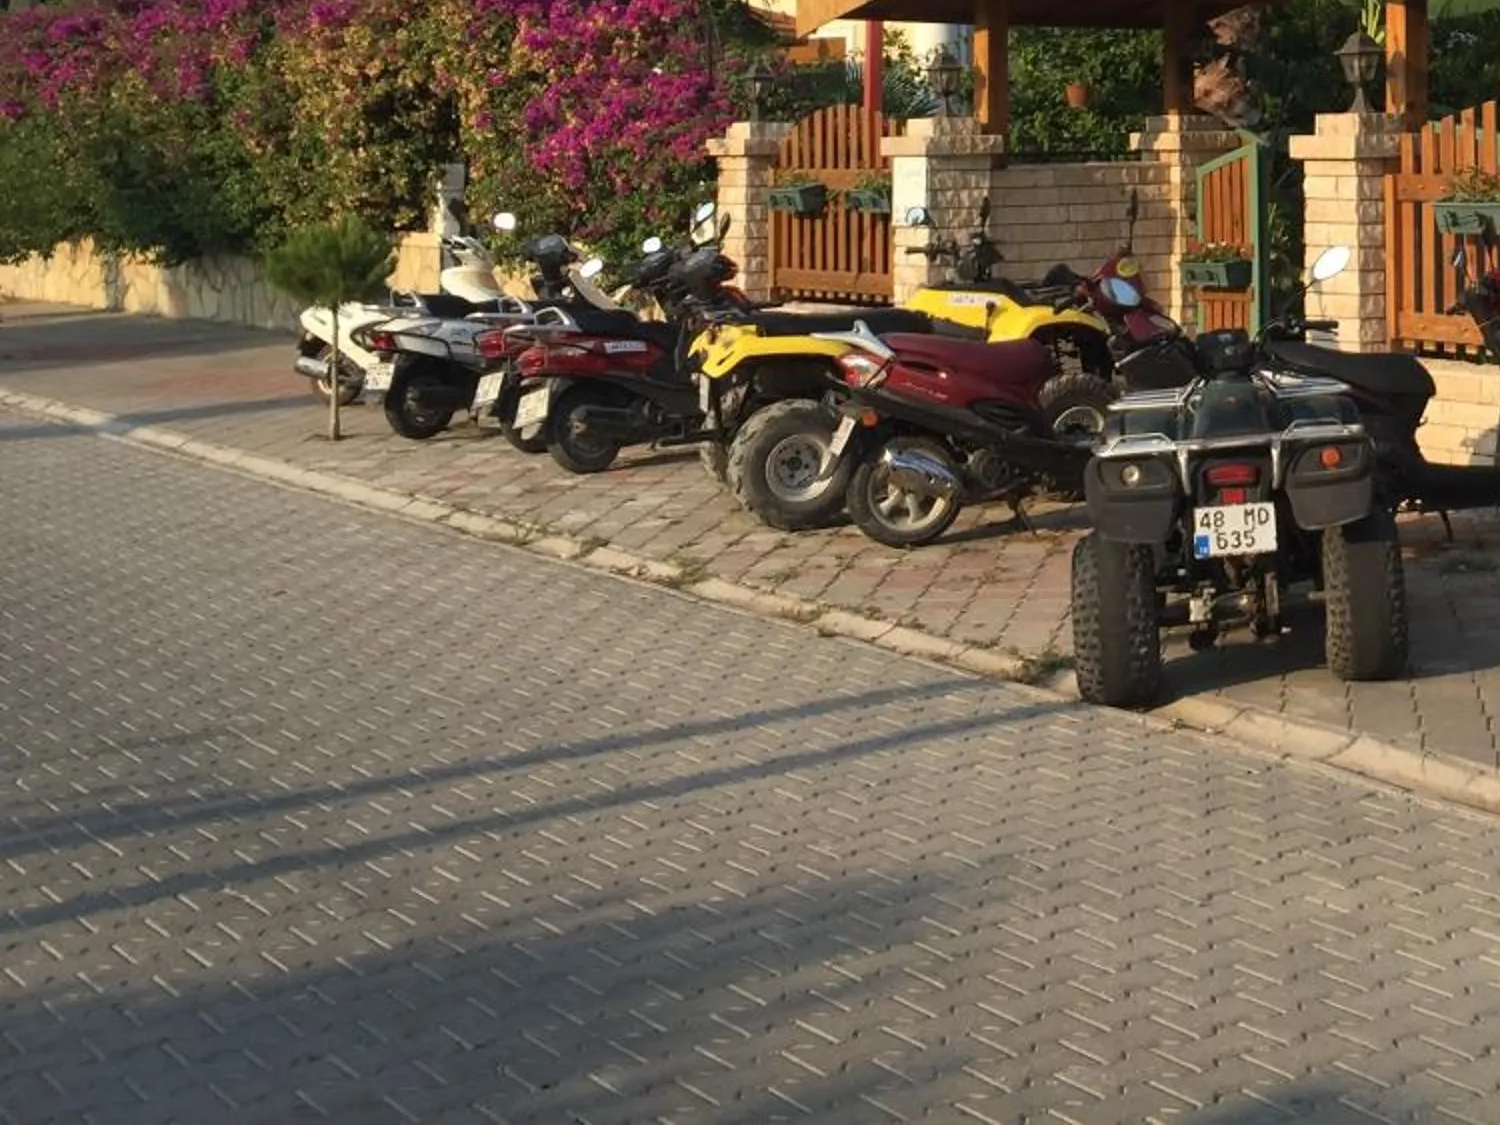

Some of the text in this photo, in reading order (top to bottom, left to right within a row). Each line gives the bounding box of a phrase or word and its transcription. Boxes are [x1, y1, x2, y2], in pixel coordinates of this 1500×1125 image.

[1200, 507, 1270, 529] 48 MD
[1216, 530, 1255, 550] 635
